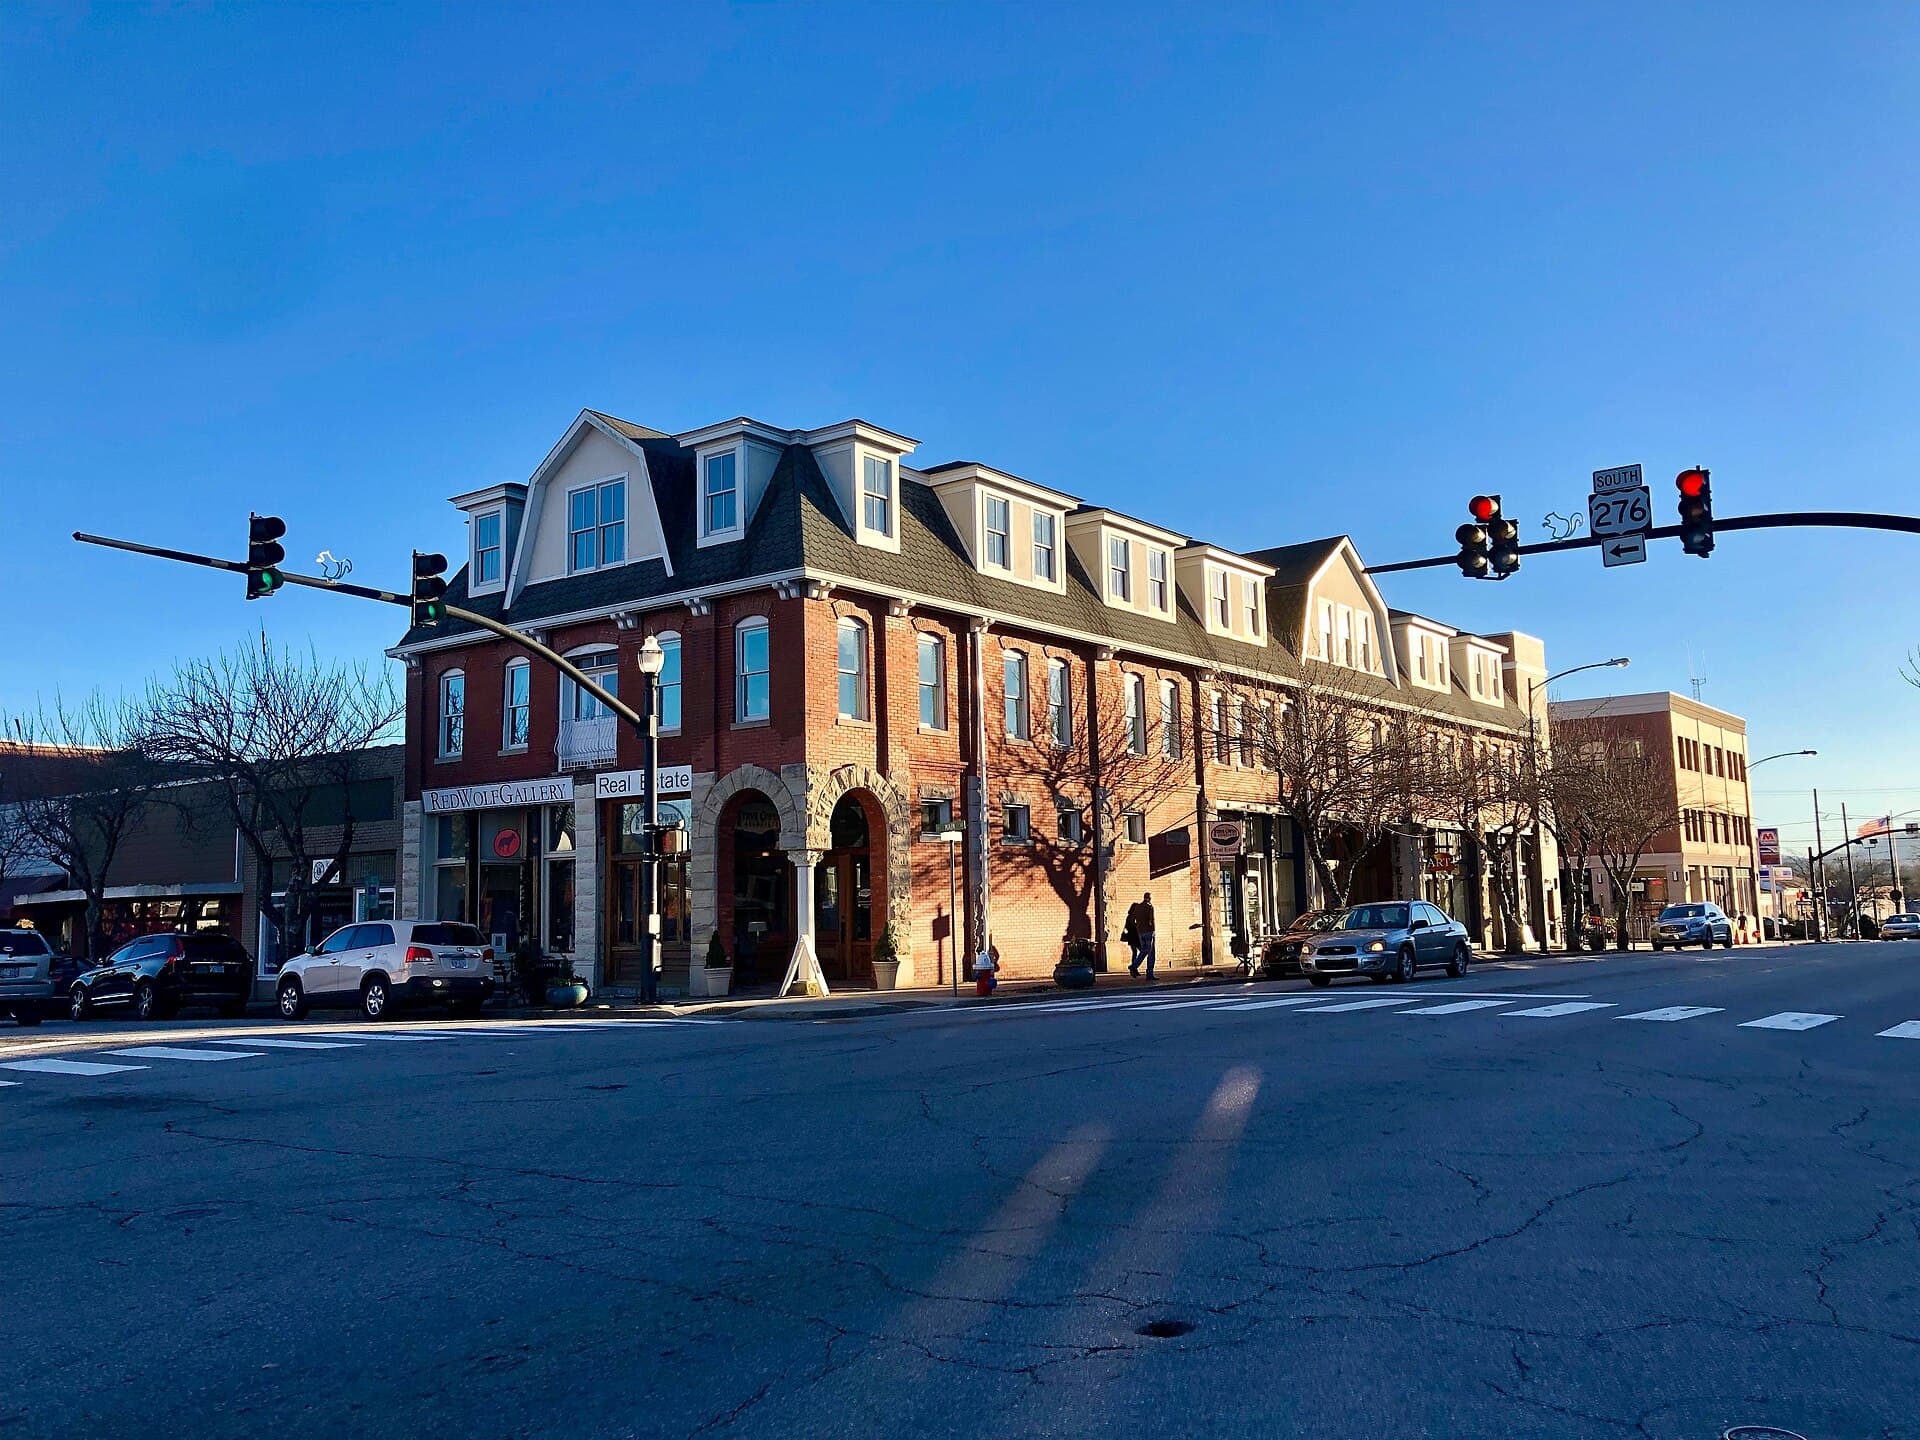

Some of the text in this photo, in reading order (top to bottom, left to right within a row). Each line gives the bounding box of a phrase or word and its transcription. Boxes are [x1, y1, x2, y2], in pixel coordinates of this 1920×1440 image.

[1597, 470, 1638, 488] SOUTH
[1594, 497, 1647, 528] 276
[599, 771, 690, 794] Real tate
[1428, 857, 1451, 867] ART
